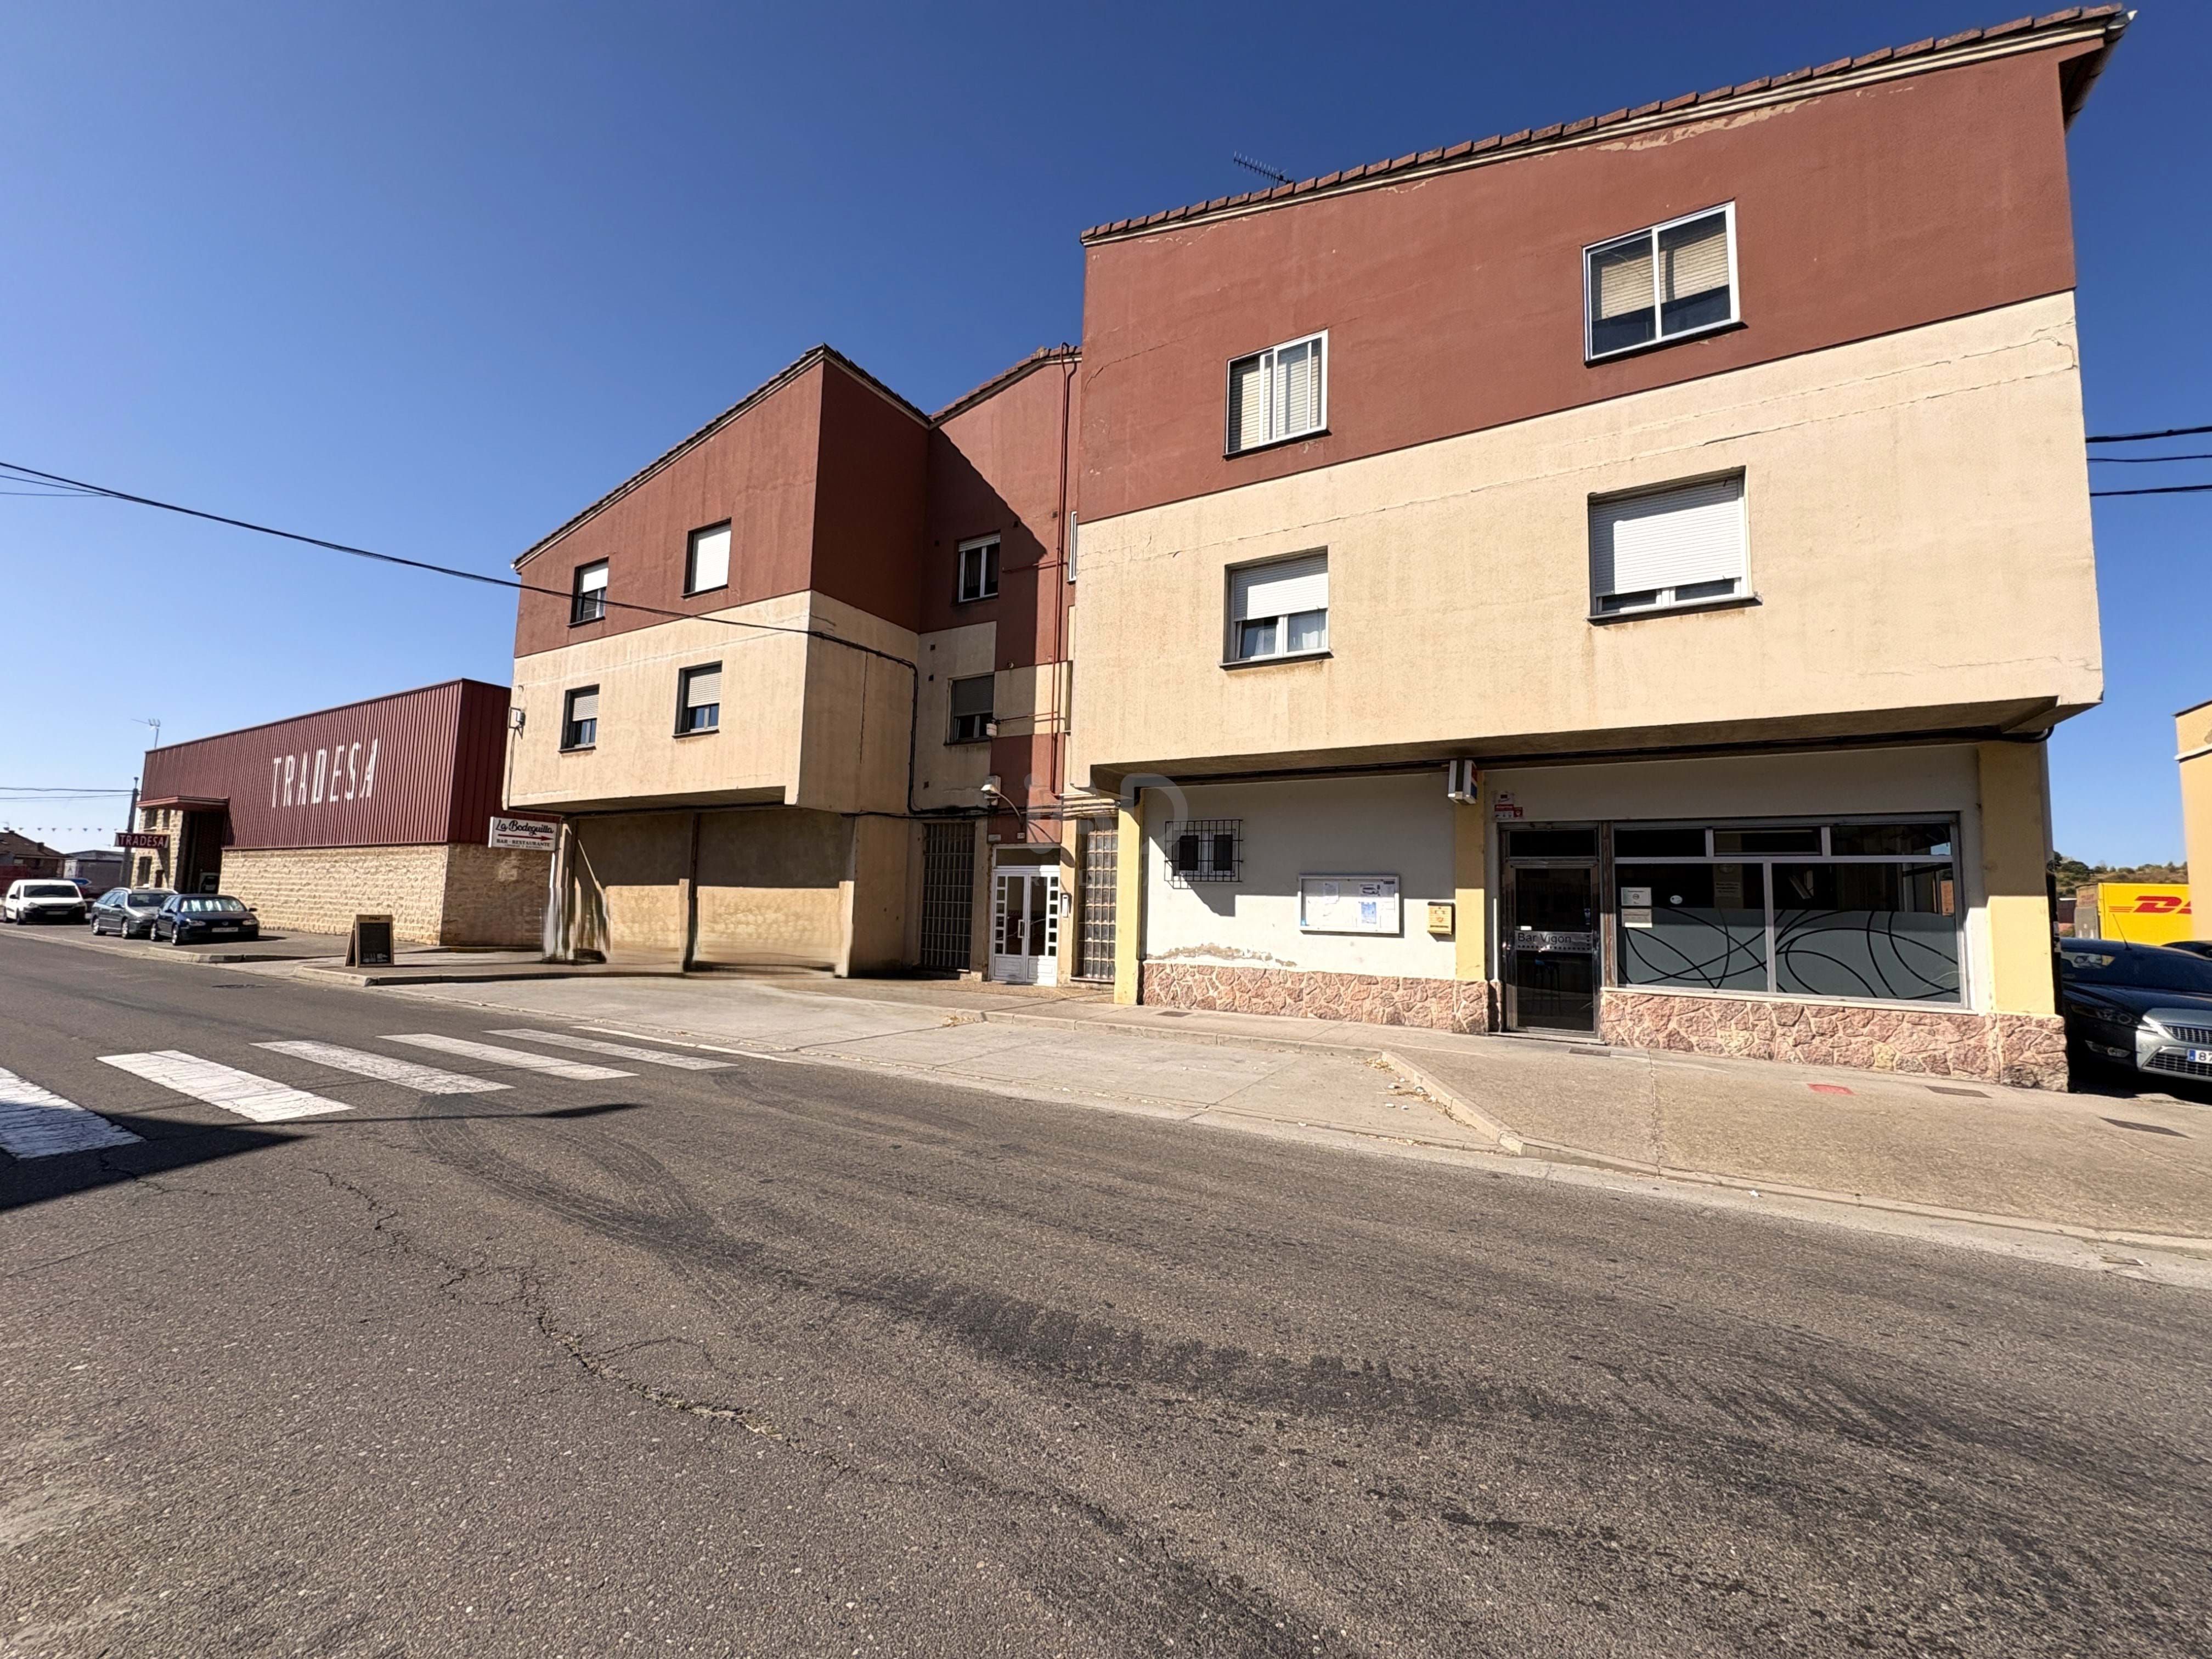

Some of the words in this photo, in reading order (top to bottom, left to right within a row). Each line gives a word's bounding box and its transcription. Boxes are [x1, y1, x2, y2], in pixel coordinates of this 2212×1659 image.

[272, 738, 378, 808] TRADESA
[495, 819, 508, 832] La
[509, 820, 554, 836] Bodeguilla
[120, 834, 164, 847] TRADESA
[512, 839, 550, 848] RESTAURANTE
[1517, 933, 1537, 942] Bar
